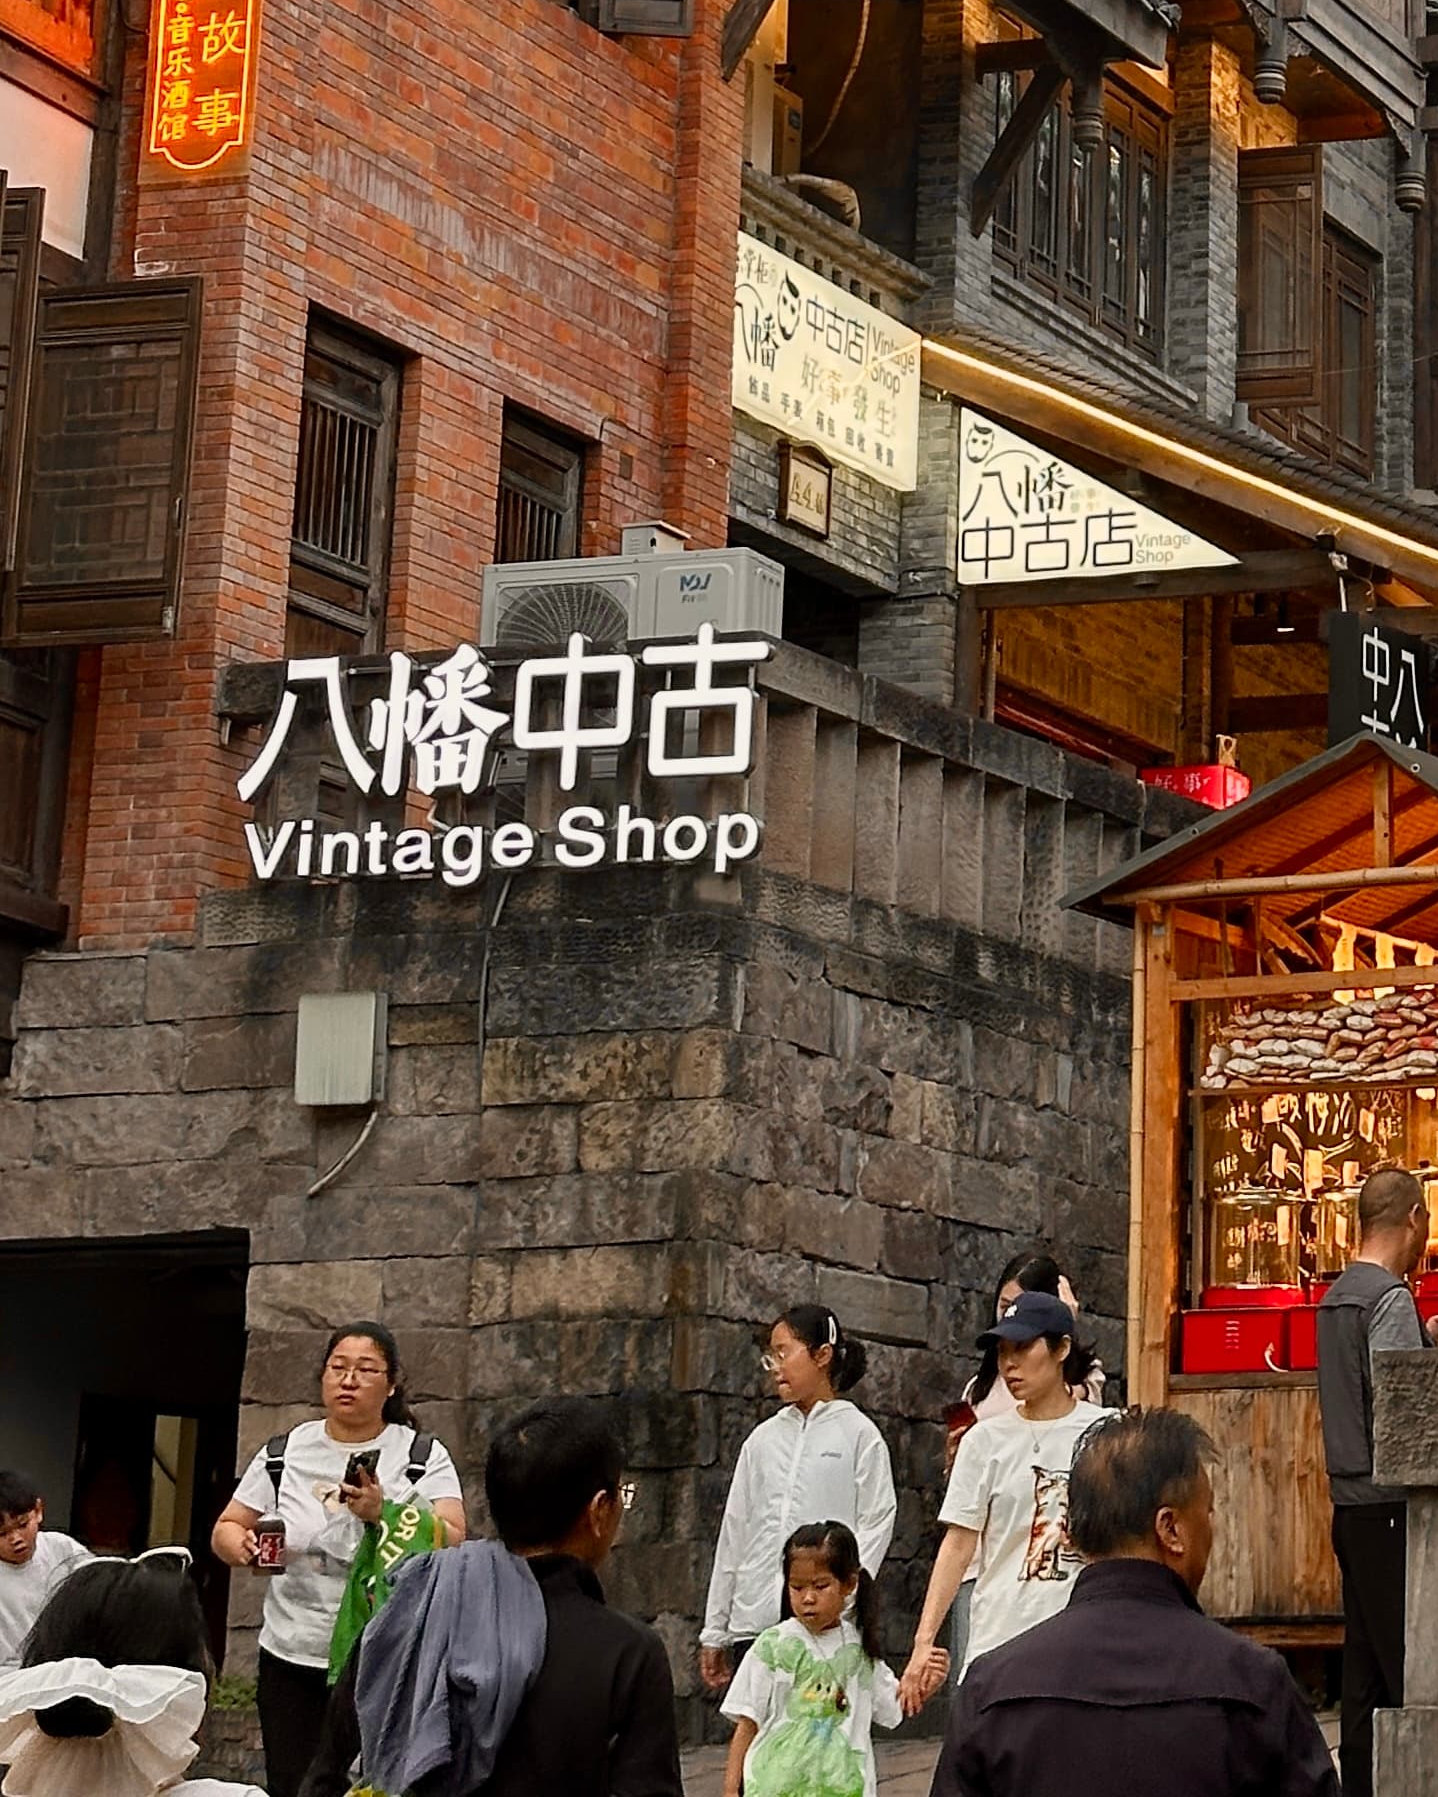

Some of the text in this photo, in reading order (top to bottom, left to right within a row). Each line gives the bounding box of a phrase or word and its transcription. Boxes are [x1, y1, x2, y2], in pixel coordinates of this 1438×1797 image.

[805, 295, 866, 365] 中古店
[962, 460, 1074, 522] 八幡
[961, 507, 1138, 580] 中古店
[1135, 533, 1192, 549] Vintage
[1135, 549, 1175, 565] Shop
[236, 621, 773, 802] 八幡中古
[243, 804, 762, 888] Vintage Shop
